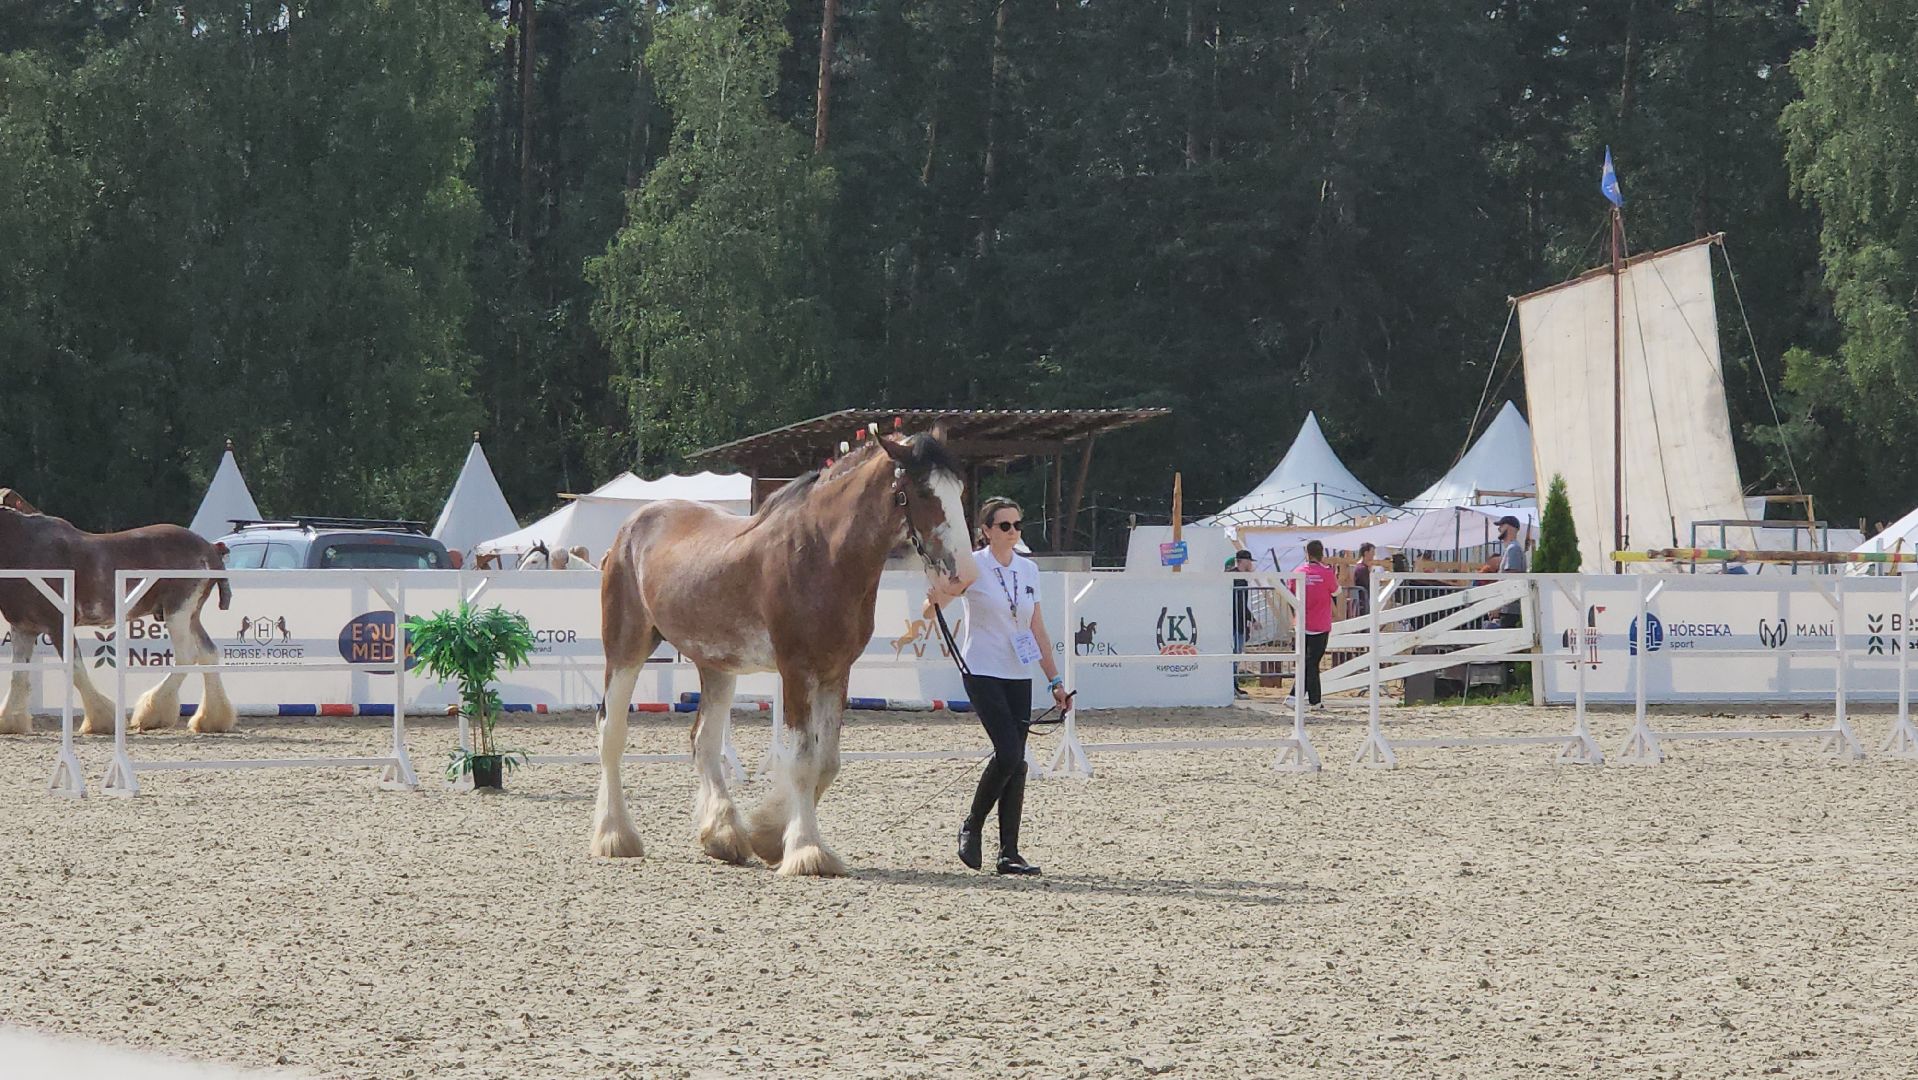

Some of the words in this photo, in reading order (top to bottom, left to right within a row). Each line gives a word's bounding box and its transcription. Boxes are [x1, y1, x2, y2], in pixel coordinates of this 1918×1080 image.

[352, 623, 396, 641] EQU
[533, 629, 577, 643] CTOR
[352, 643, 416, 660] MEDA
[1669, 640, 1695, 650] sport
